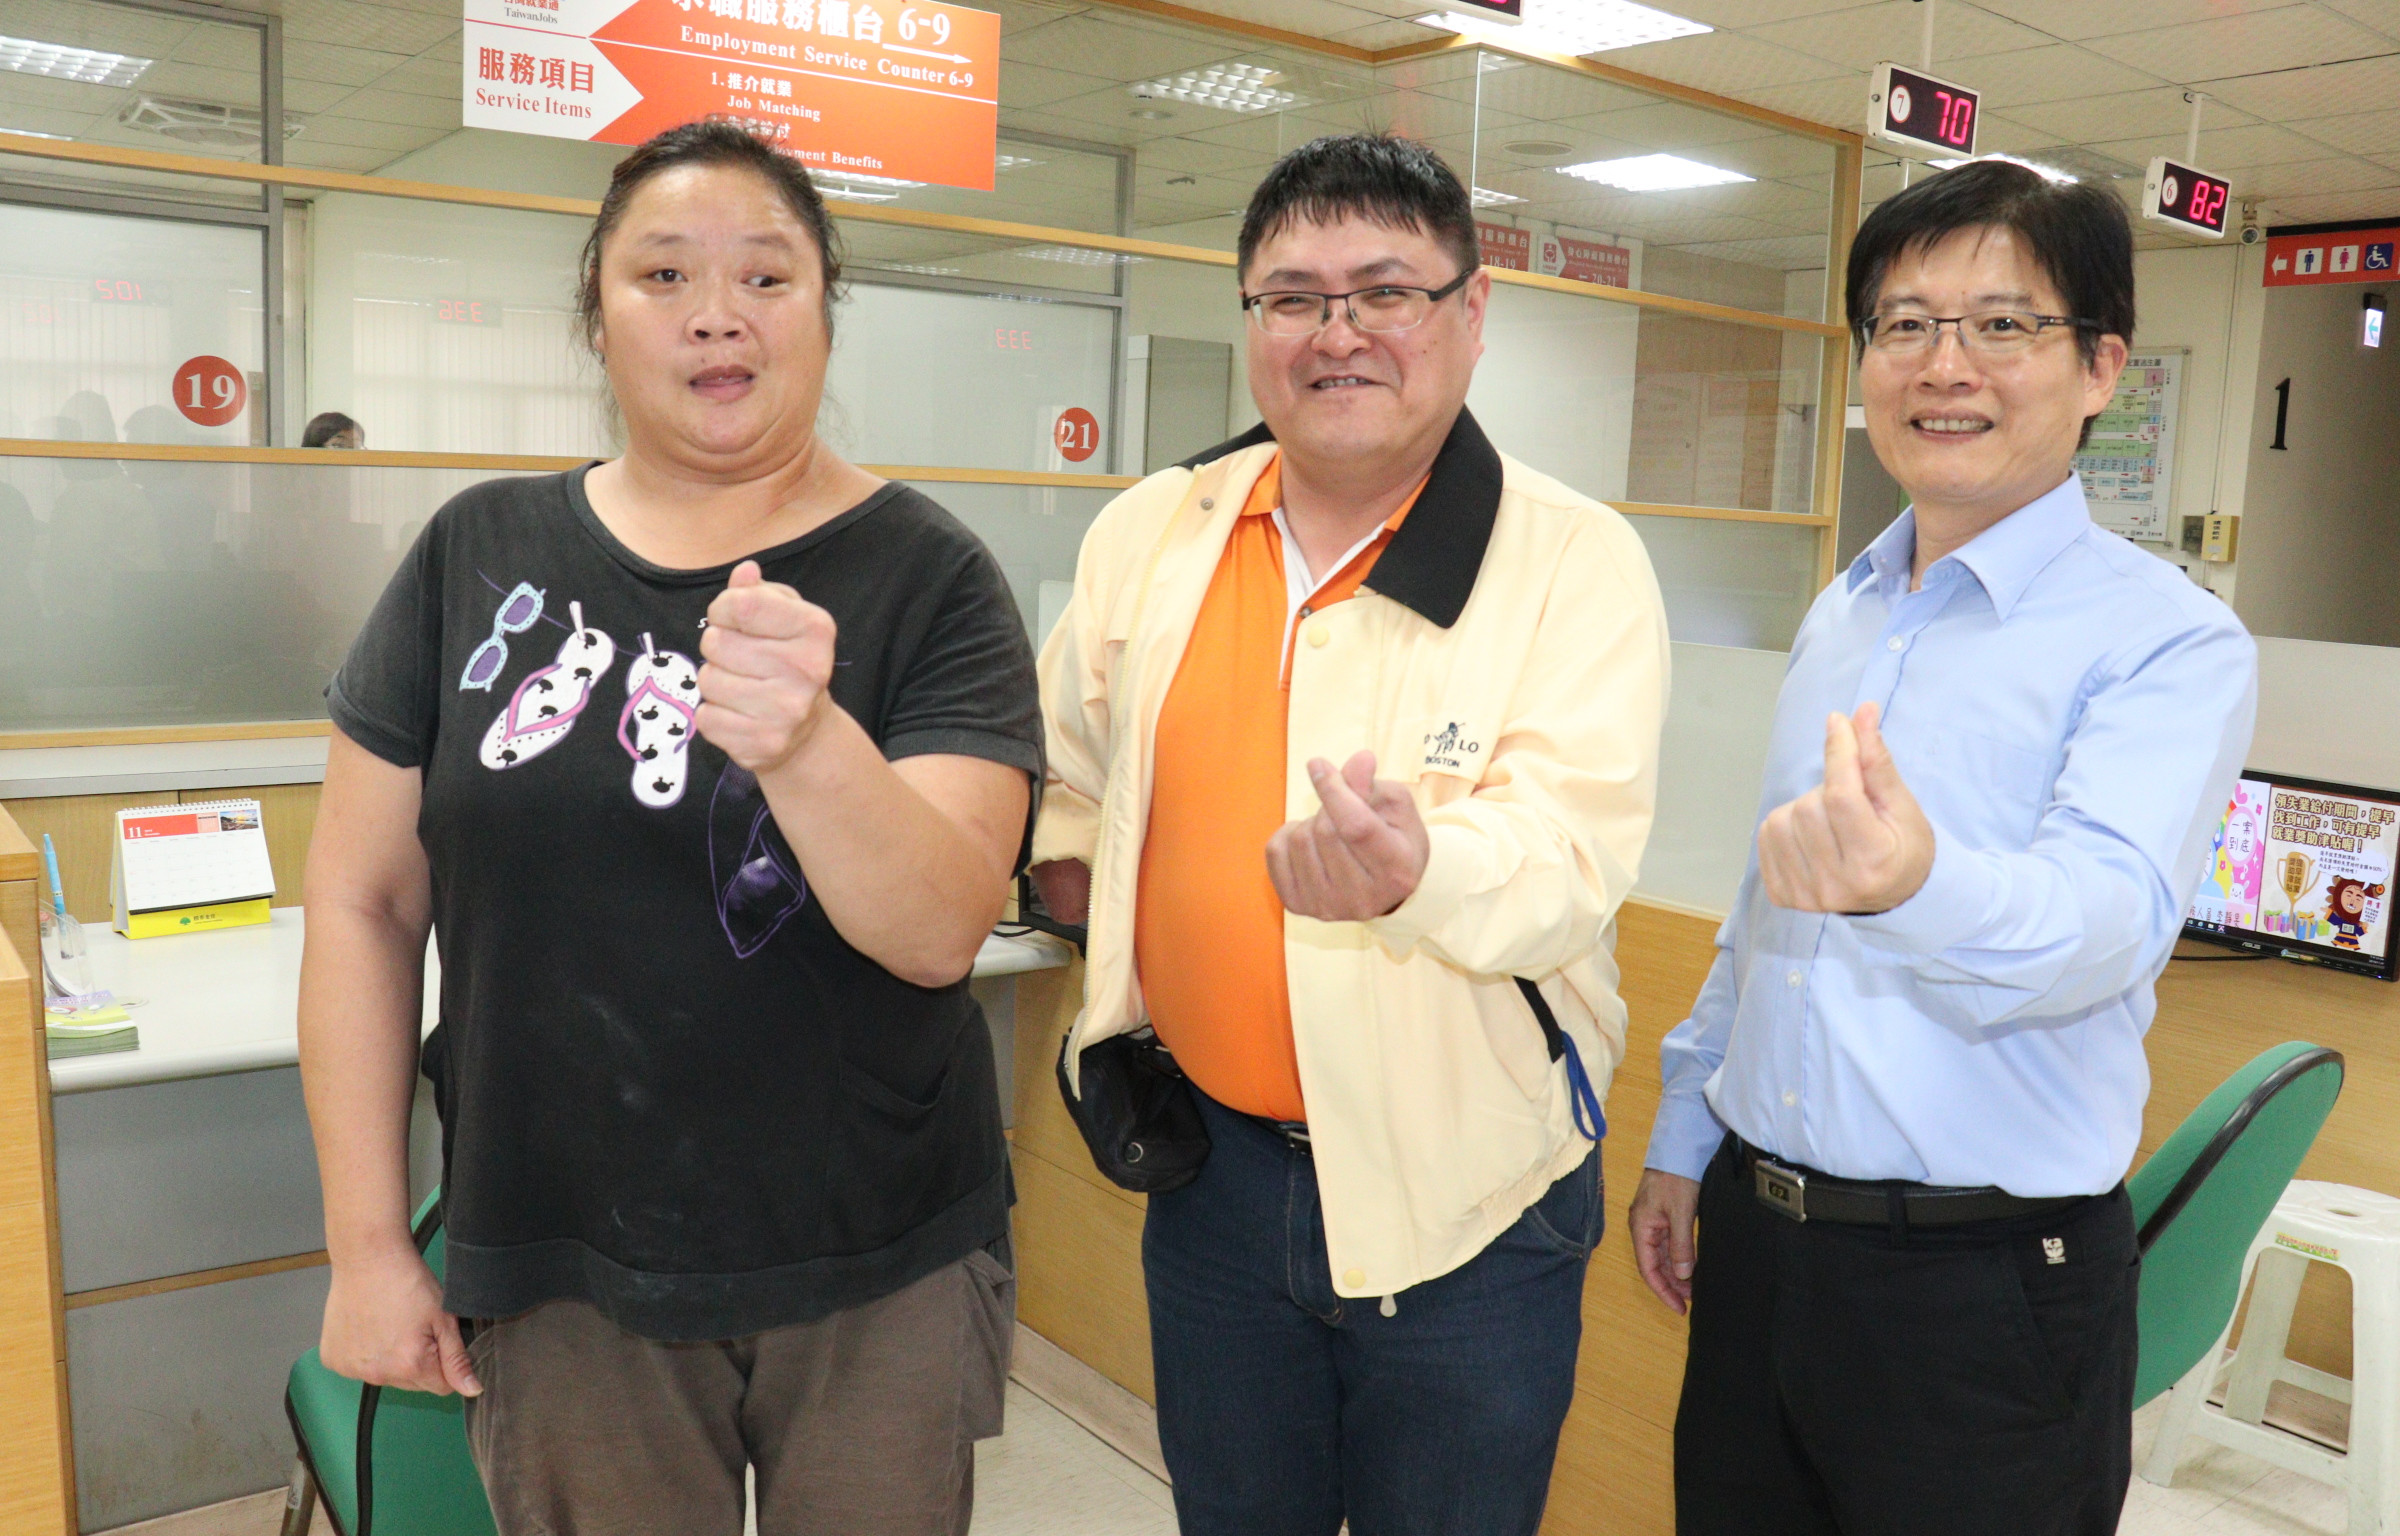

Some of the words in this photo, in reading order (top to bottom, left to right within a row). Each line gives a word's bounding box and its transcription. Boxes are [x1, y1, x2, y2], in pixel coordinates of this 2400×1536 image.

[504, 7, 558, 24] TaiwanJobs
[672, 0, 884, 43] 職服務櫃台
[898, 8, 950, 46] 6-9
[478, 46, 594, 94] 服務項目
[680, 25, 796, 60] Employment
[804, 45, 868, 71] Service
[877, 58, 945, 84] Counter
[948, 70, 974, 88] 6-9
[476, 87, 540, 112] Service
[545, 96, 592, 119] Items
[727, 95, 752, 110] Job
[758, 99, 821, 123] Matching
[1895, 93, 1906, 114] 7
[1934, 91, 1971, 145] 70
[831, 151, 883, 170] Benefits
[2165, 182, 2174, 200] 6
[2189, 180, 2226, 226] 82
[185, 372, 237, 410] 19
[2269, 377, 2291, 451] 1
[1060, 420, 1091, 450] 21
[1425, 755, 1460, 768] BOSTON
[127, 826, 142, 839] 11
[2273, 809, 2381, 840] 找到工作，可有提早
